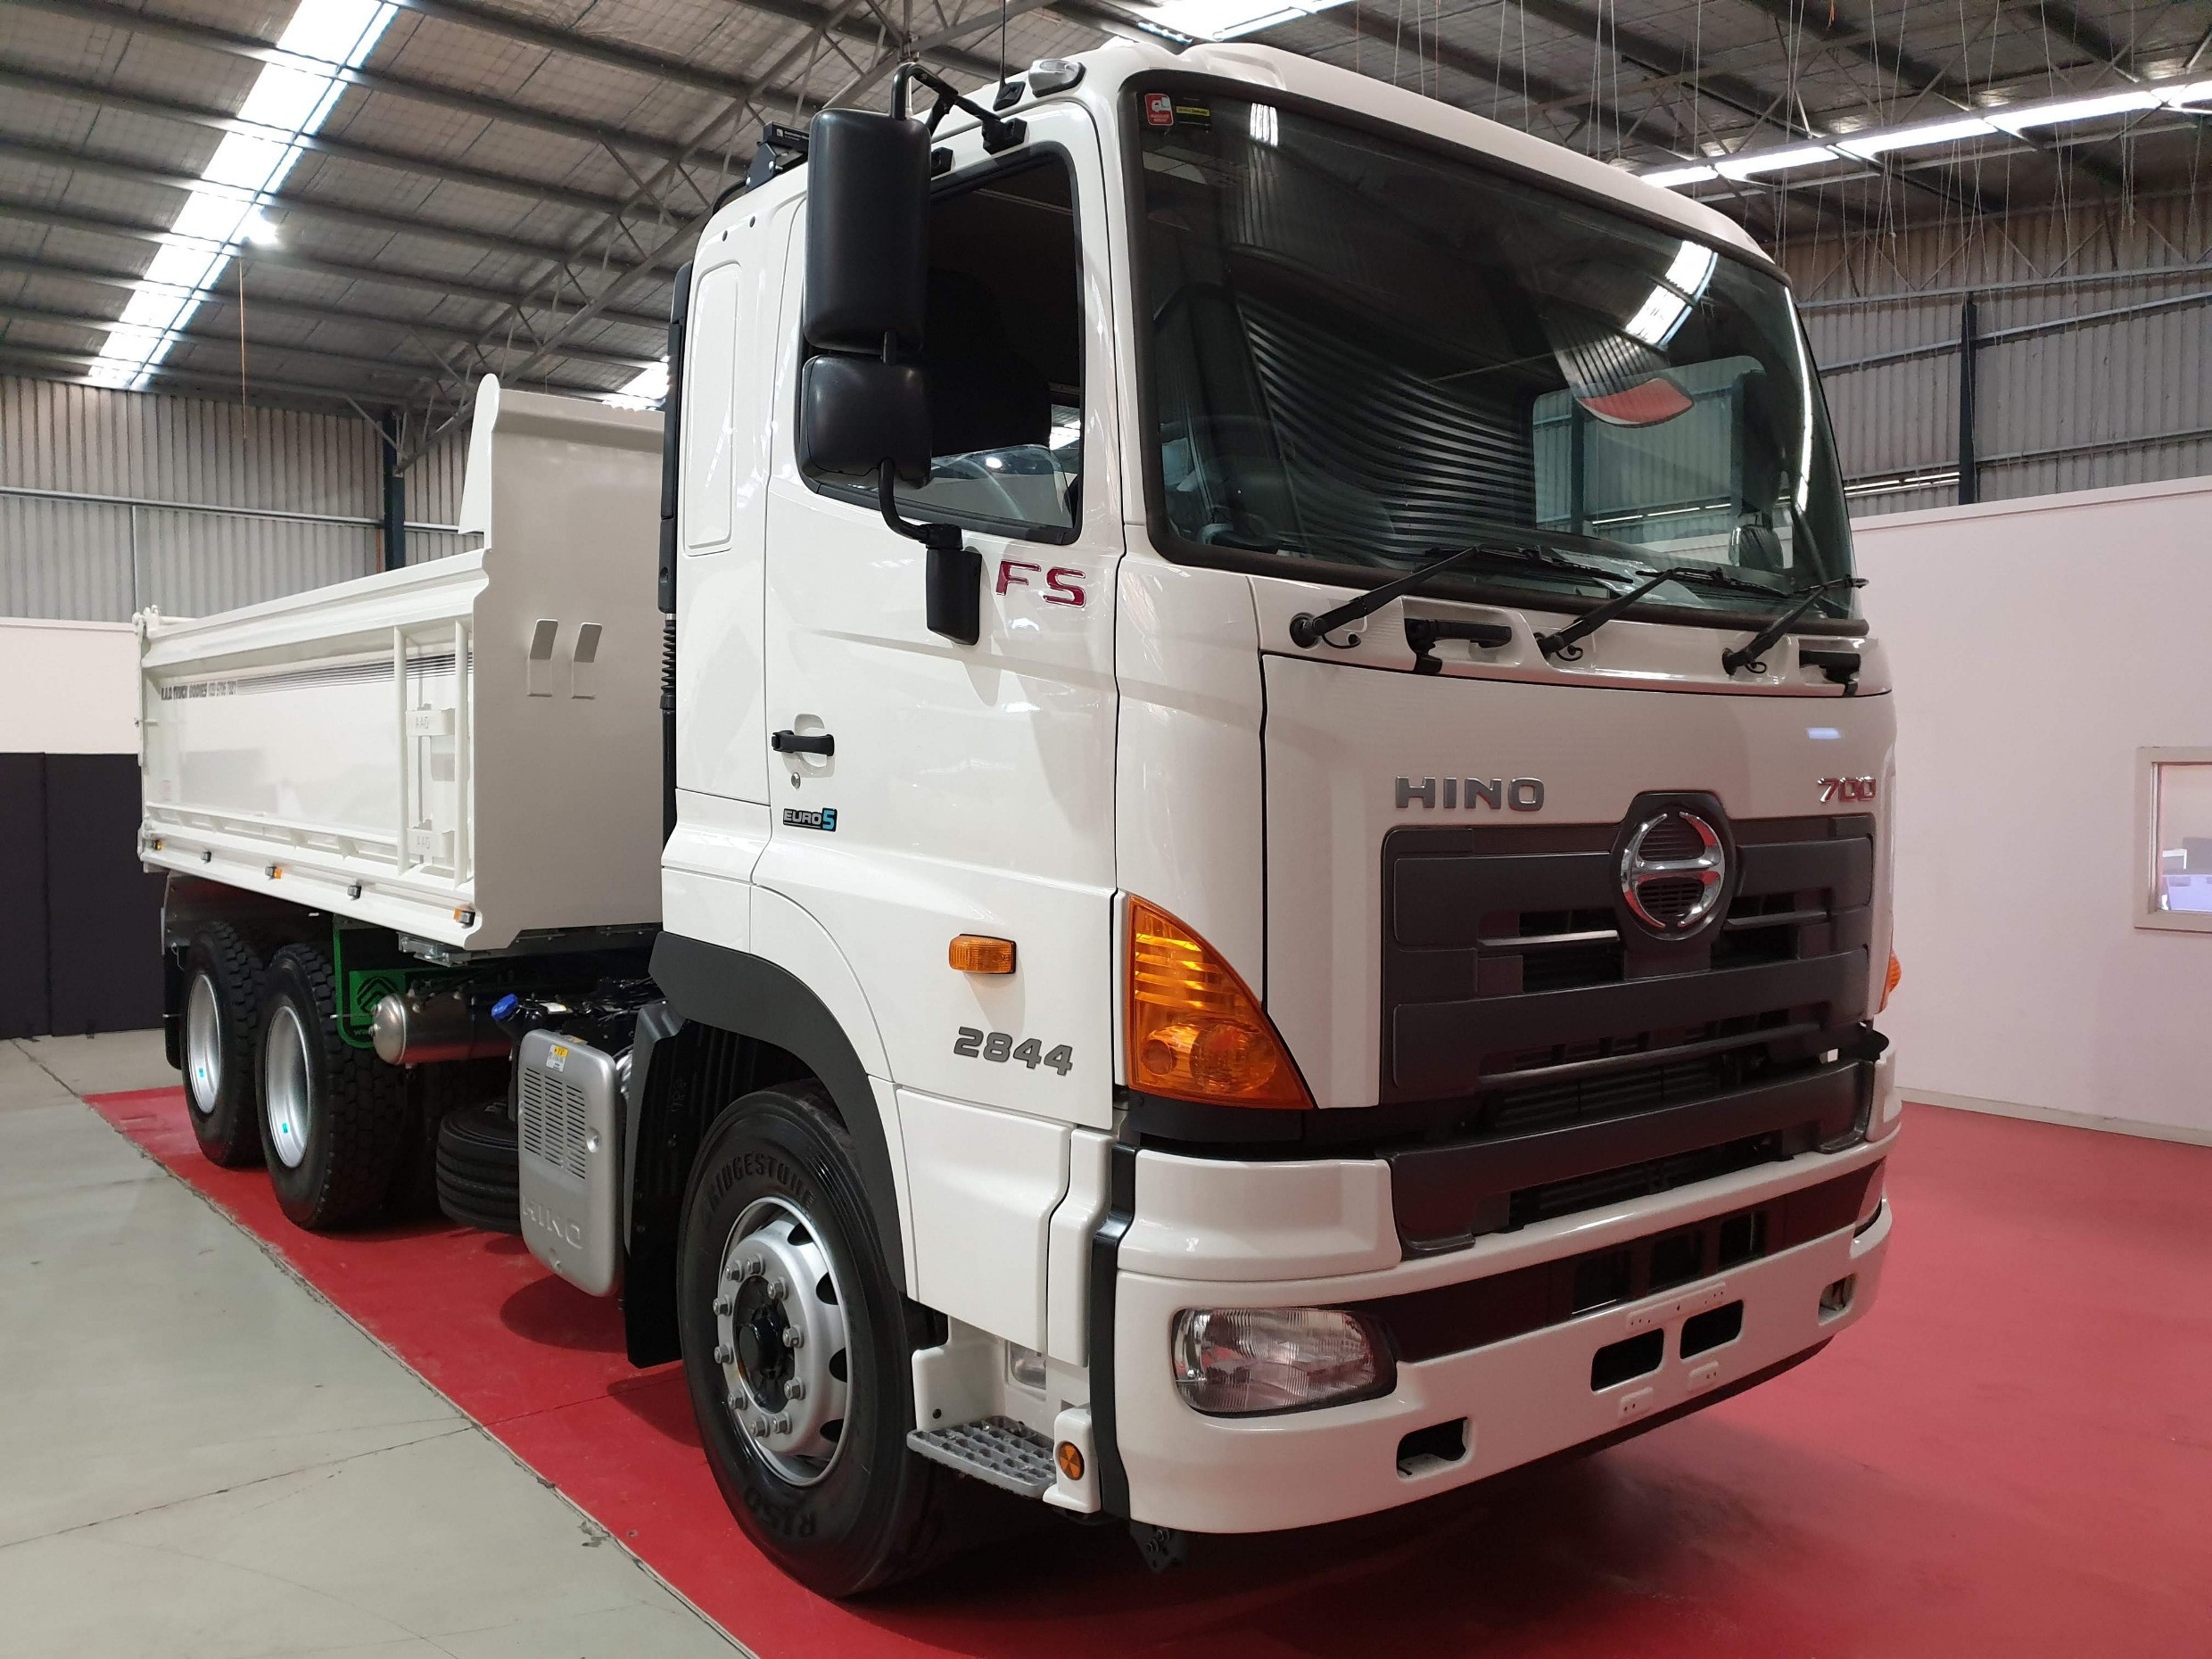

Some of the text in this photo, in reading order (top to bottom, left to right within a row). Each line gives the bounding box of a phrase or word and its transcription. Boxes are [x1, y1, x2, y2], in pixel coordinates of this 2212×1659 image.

[995, 560, 1086, 608] FS
[1394, 776, 1545, 812] HINO
[1817, 775, 1877, 803] 700
[953, 1026, 1073, 1076] 2844
